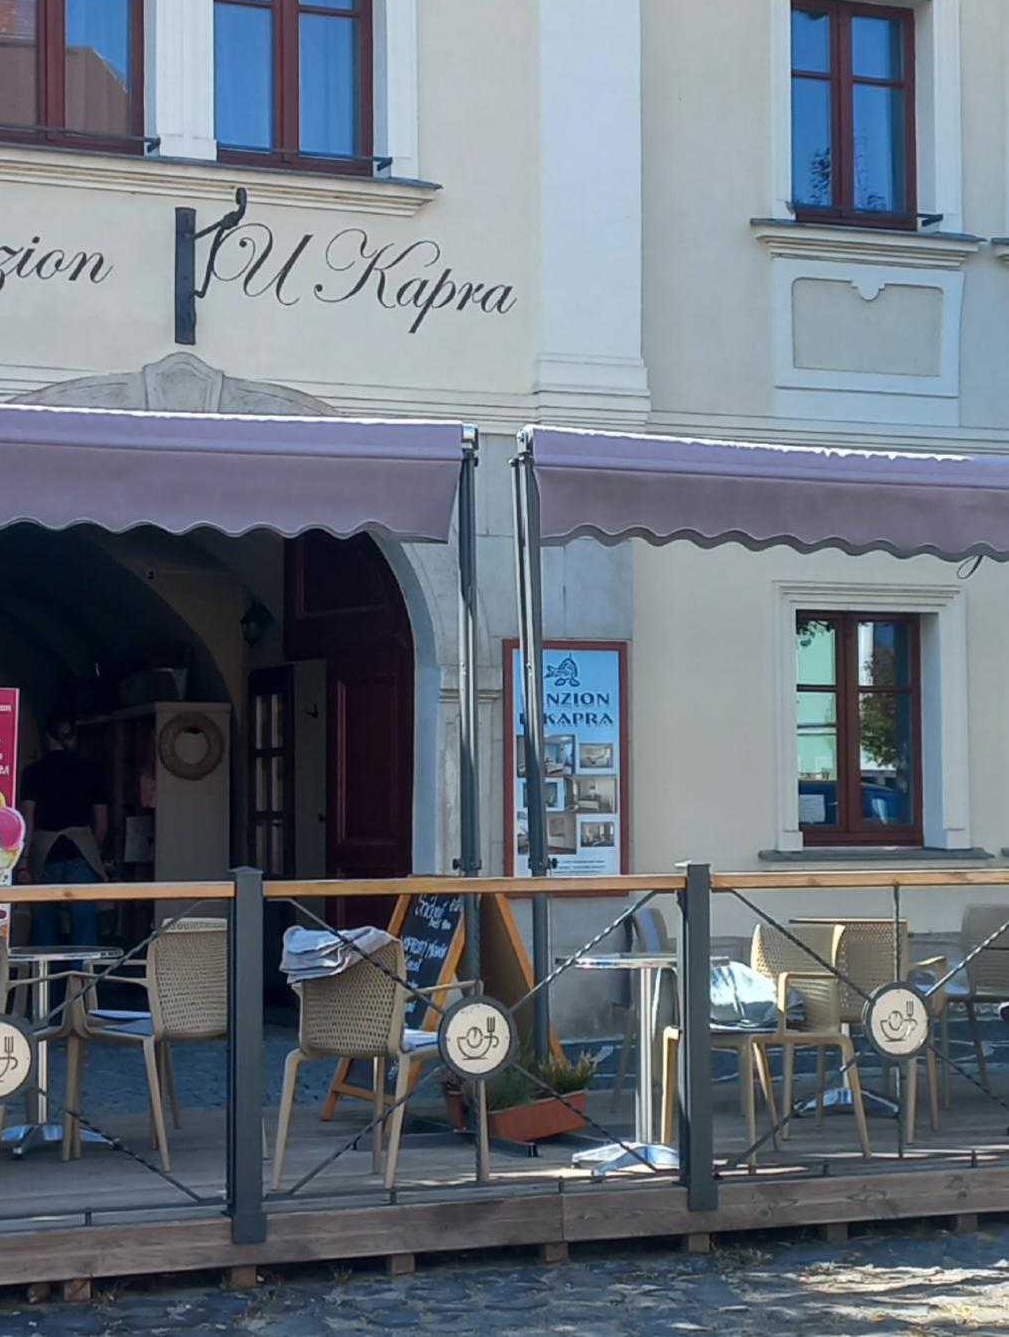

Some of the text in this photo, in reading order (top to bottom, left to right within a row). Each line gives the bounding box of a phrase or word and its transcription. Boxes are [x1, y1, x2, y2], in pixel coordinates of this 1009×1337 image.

[211, 222, 314, 306] U
[313, 228, 518, 334] Kapra
[543, 692, 610, 706] NZION
[543, 712, 614, 725] KAPRA
